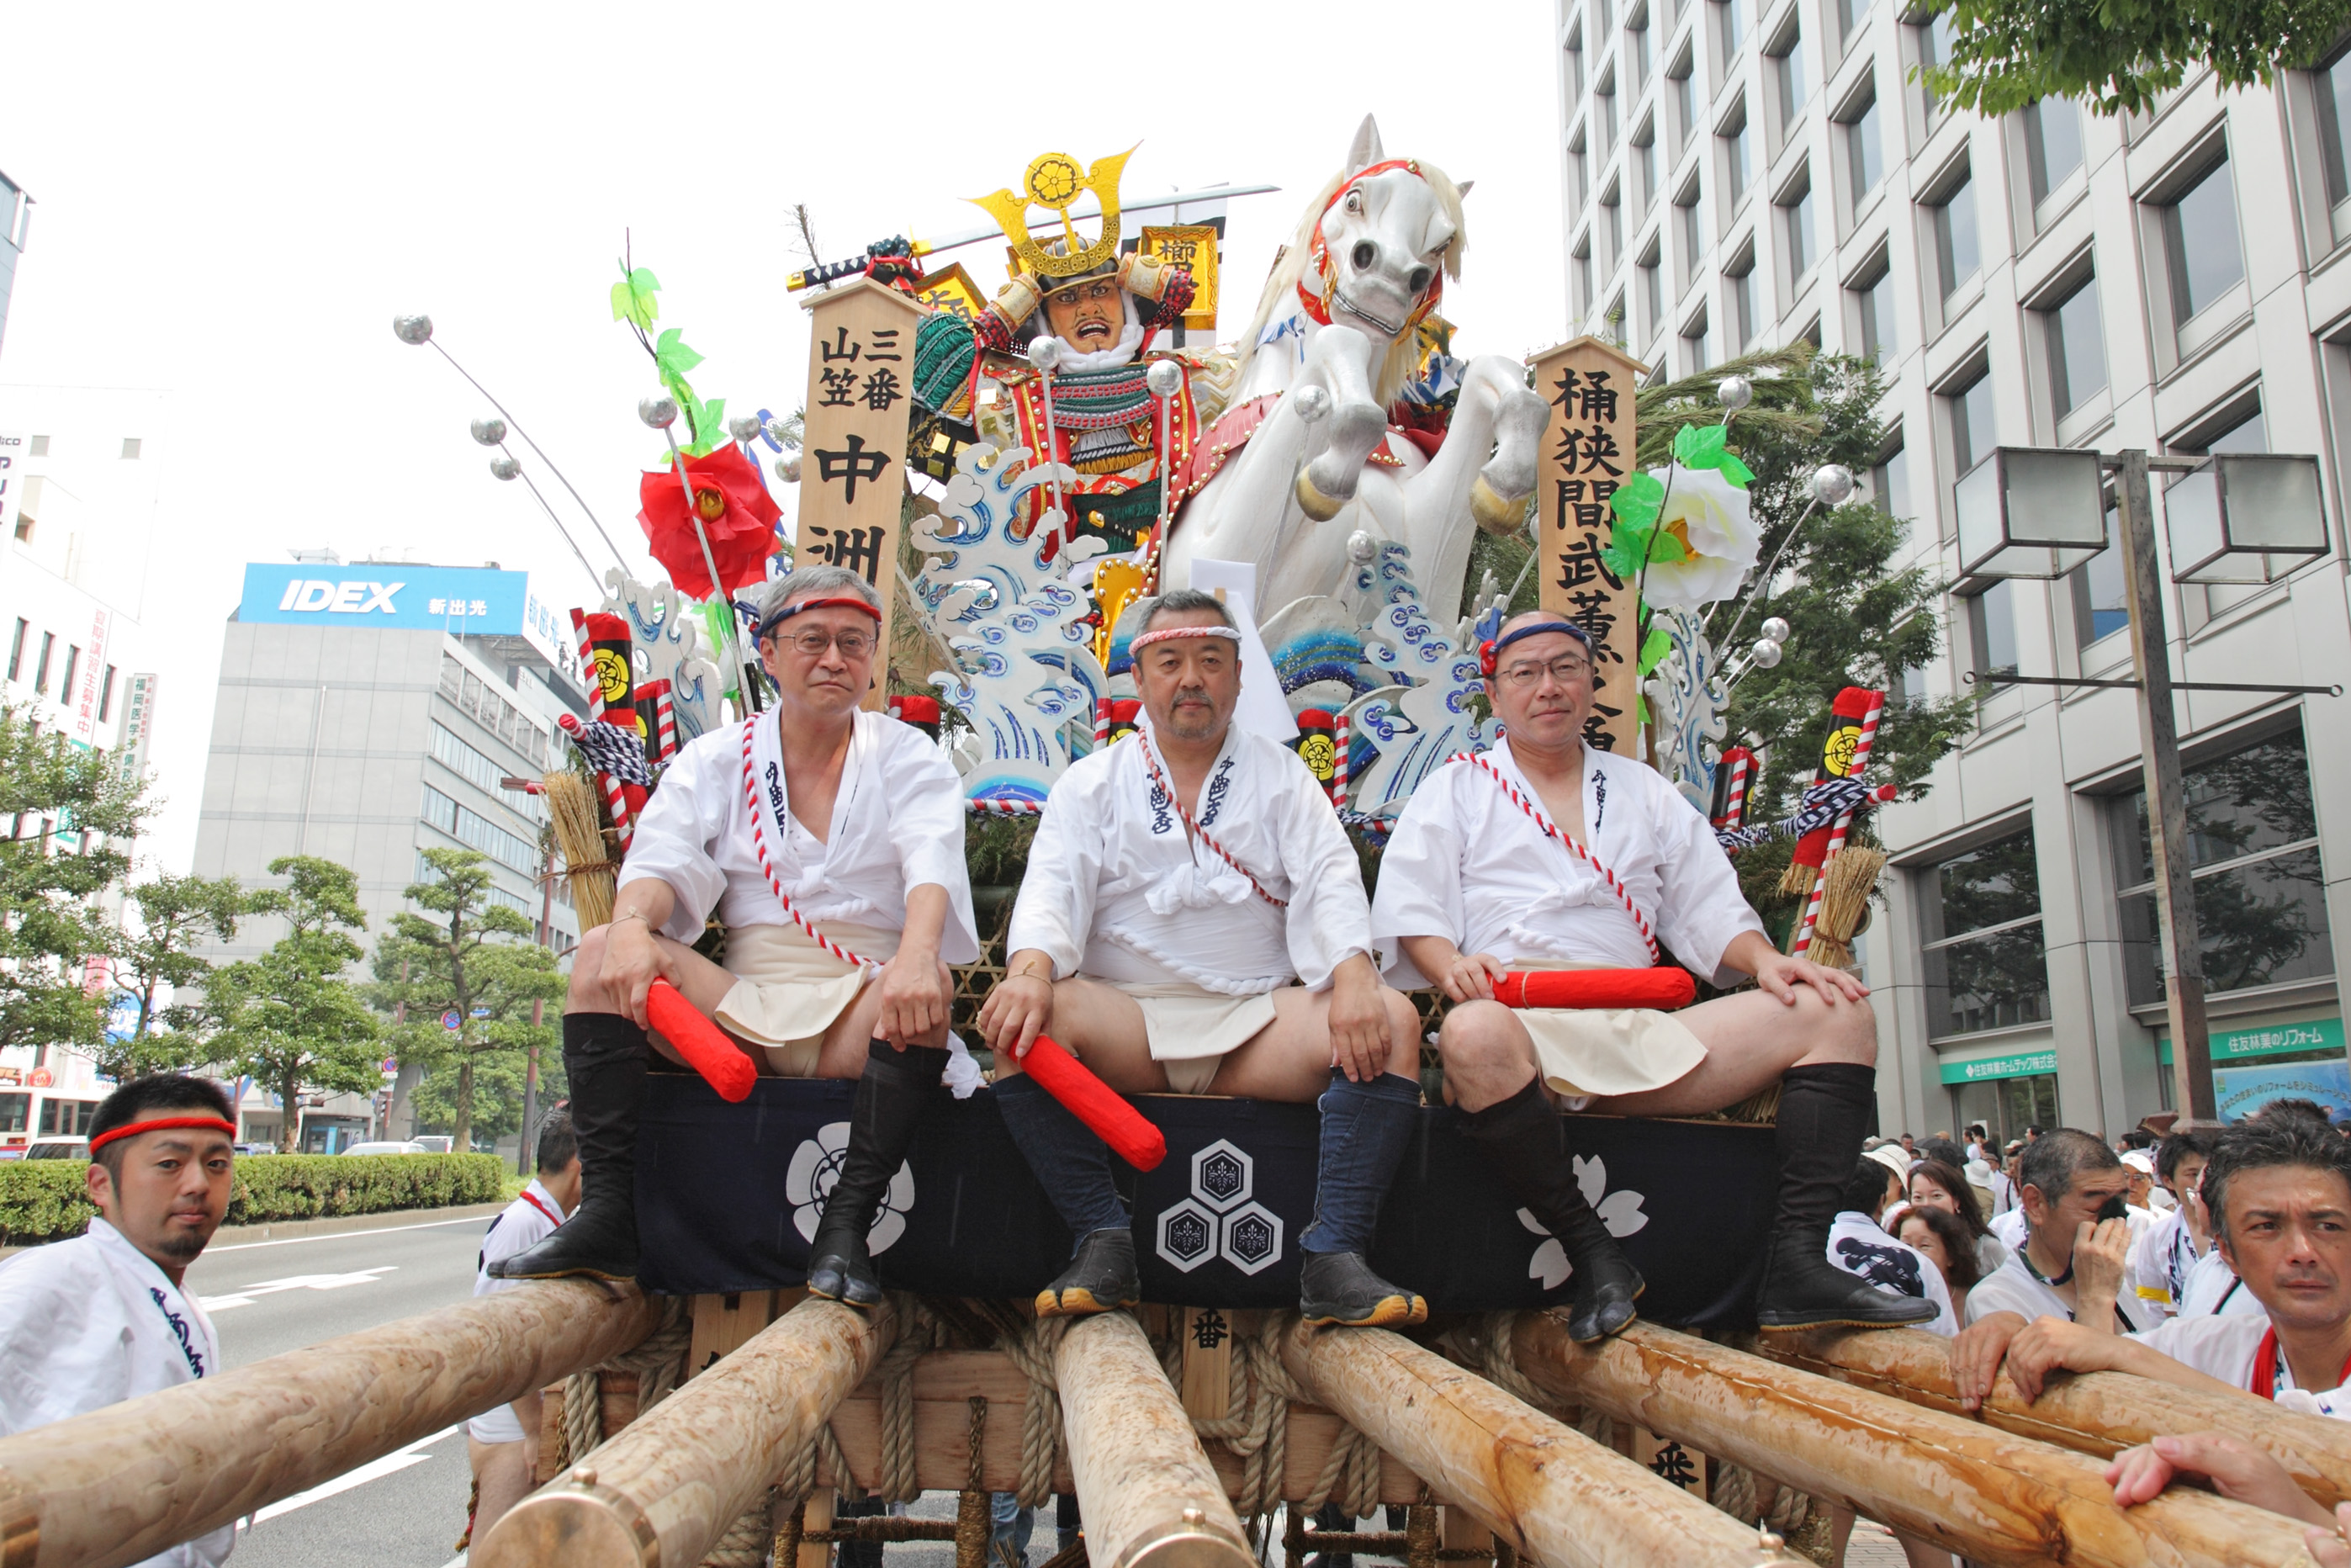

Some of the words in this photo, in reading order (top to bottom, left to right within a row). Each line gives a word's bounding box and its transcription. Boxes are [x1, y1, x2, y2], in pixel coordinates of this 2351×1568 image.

[818, 326, 861, 407] 山笠
[858, 330, 903, 411] 三番
[279, 580, 407, 614] IDEX
[428, 598, 488, 616] 新出光
[2228, 1027, 2323, 1053] 住友林業のリフォーム
